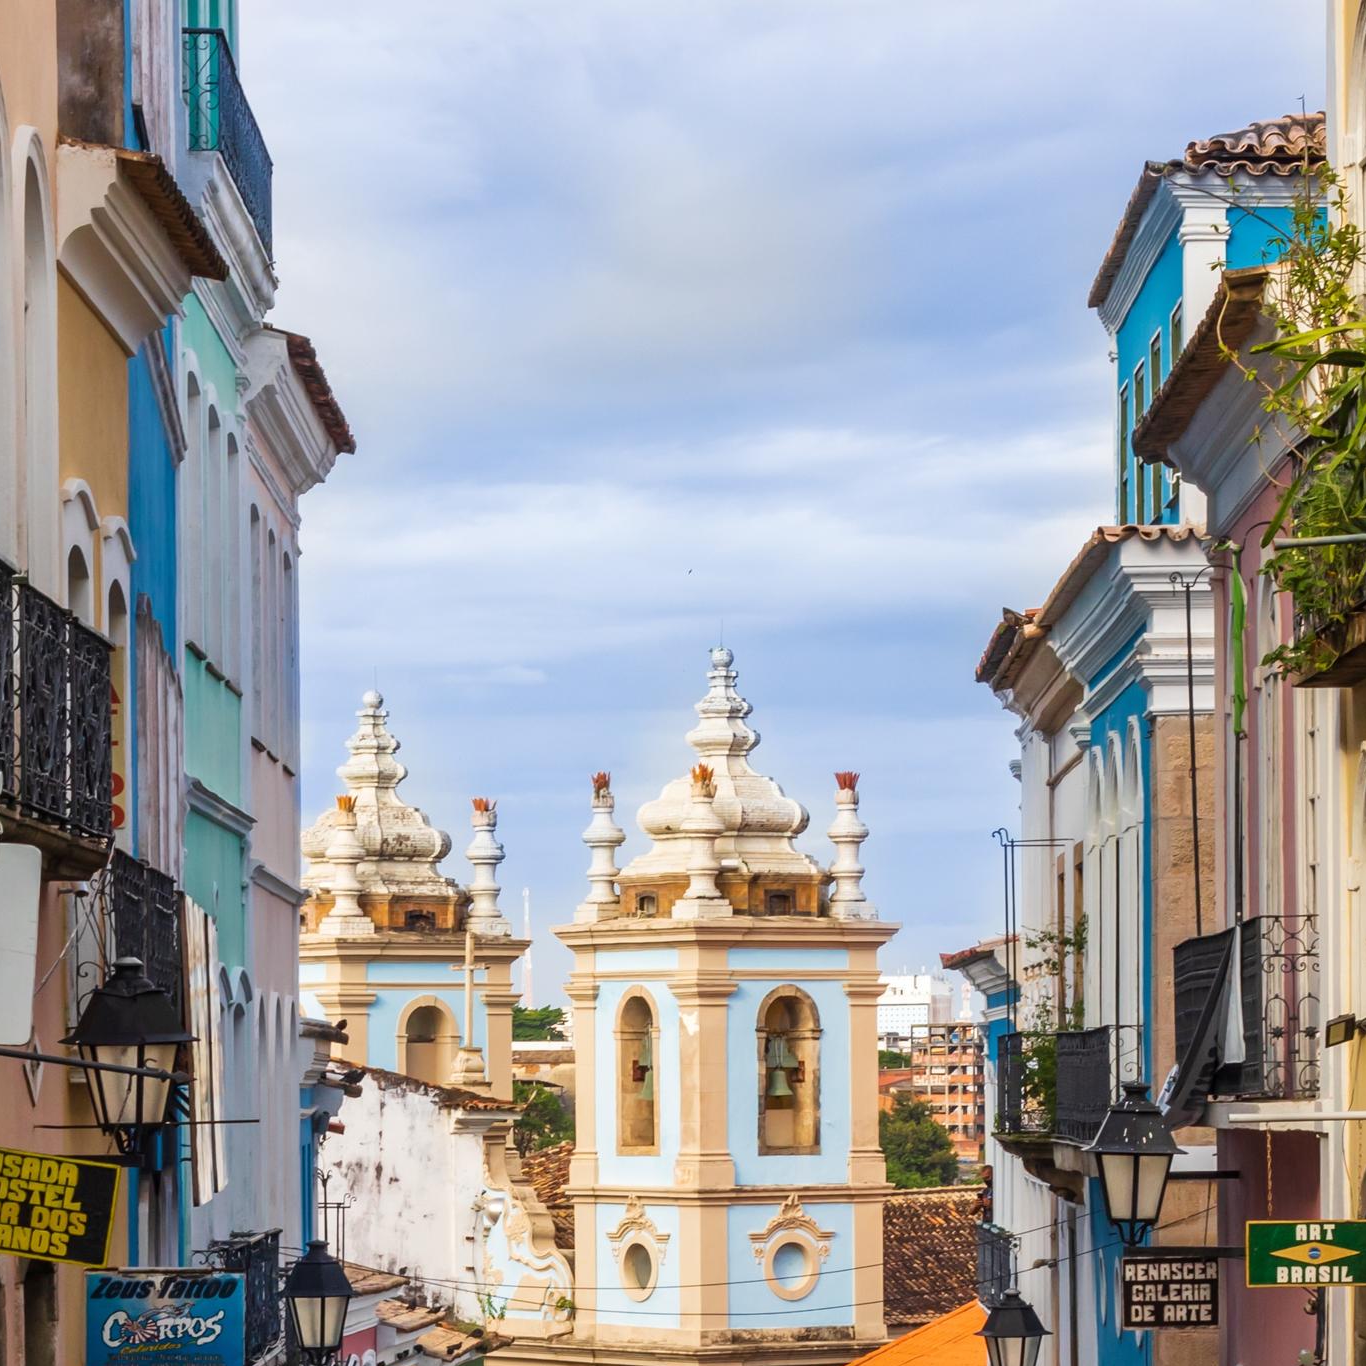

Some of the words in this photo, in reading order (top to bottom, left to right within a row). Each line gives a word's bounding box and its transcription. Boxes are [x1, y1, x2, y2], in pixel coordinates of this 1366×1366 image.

[31, 1206, 87, 1236] DOS
[1296, 1223, 1336, 1241] ART
[1124, 1262, 1217, 1281] RENASCER
[1276, 1266, 1353, 1283] BRASIL
[90, 1277, 156, 1299] Zeus
[158, 1276, 239, 1299] Tattoo
[1132, 1284, 1211, 1302] GALERIA
[1131, 1304, 1155, 1322] DE
[1163, 1303, 1212, 1321] ARTE
